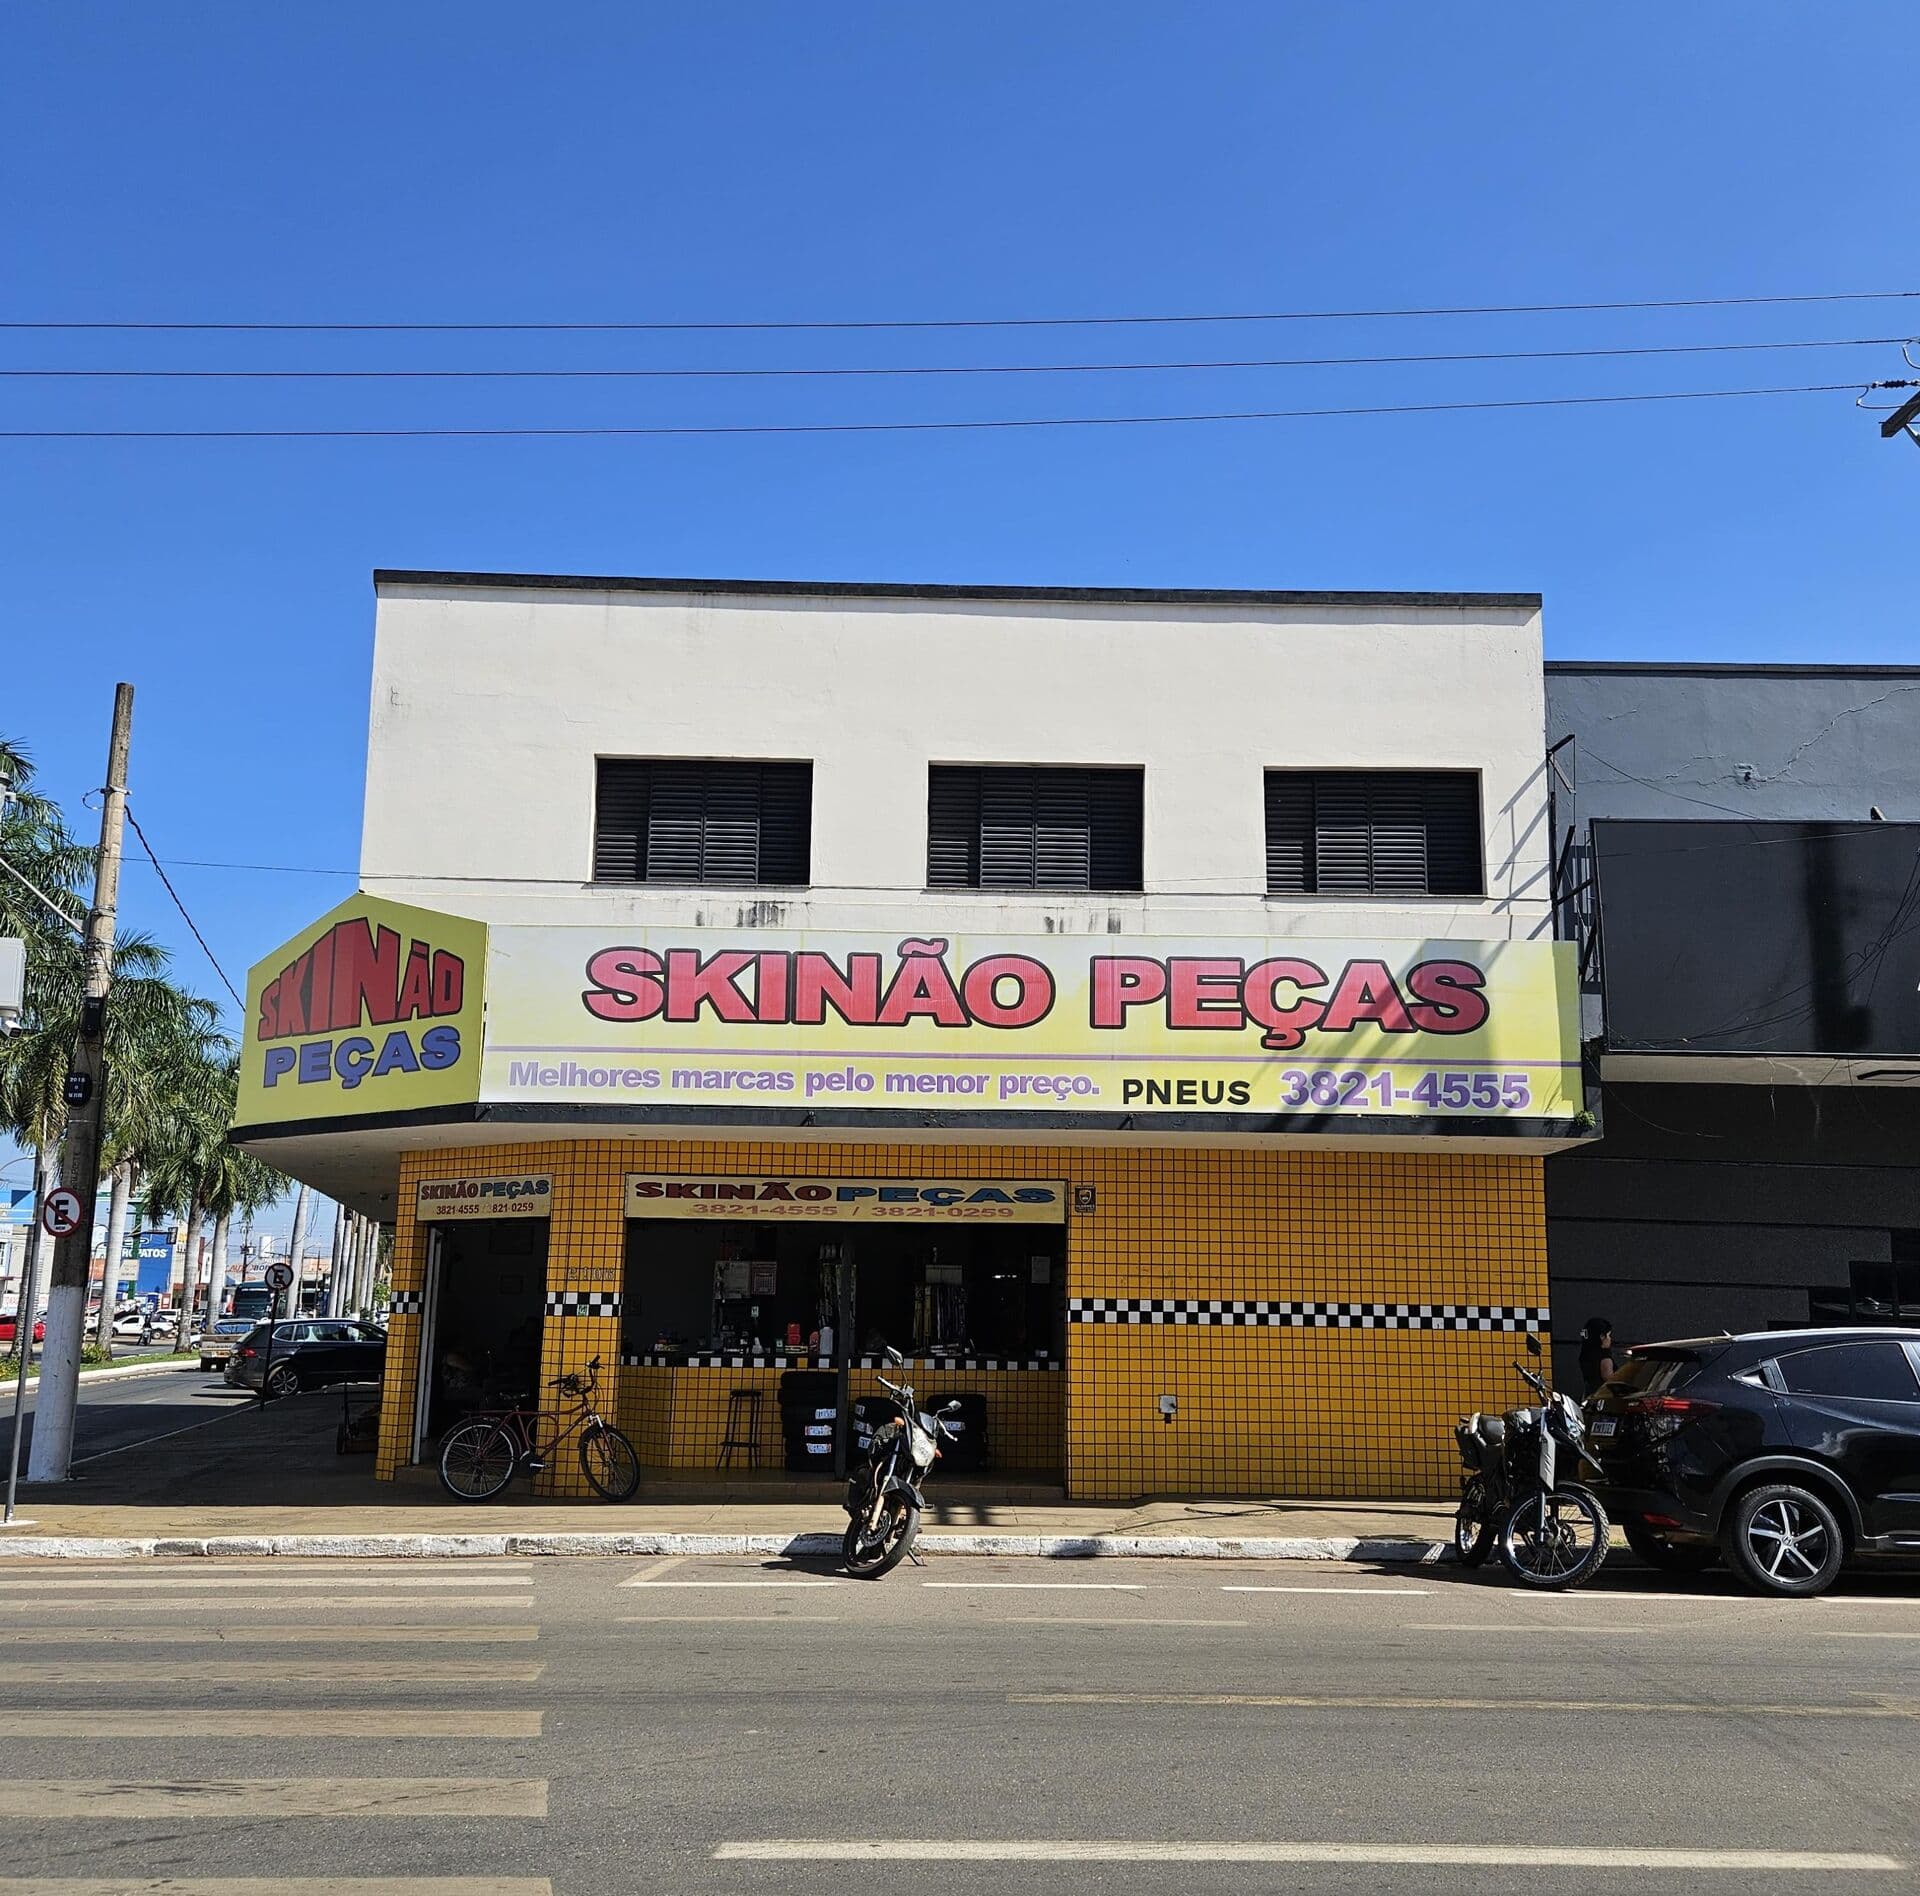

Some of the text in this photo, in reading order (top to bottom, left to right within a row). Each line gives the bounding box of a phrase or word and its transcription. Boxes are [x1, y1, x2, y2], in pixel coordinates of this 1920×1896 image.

[257, 916, 465, 1041] SKINÃO
[582, 938, 1490, 1050] SKINÃO PEÇAS
[263, 1025, 461, 1089] PEÇAS
[509, 1061, 1100, 1101] Melhores marcas pelo menor preço.
[1123, 1069, 1531, 1110] PNEUS 3821-4555
[436, 1202, 534, 1215] 3821-4555 821-0259
[692, 1203, 837, 1215] 3821-4555
[871, 1207, 1014, 1218] 3821-0259
